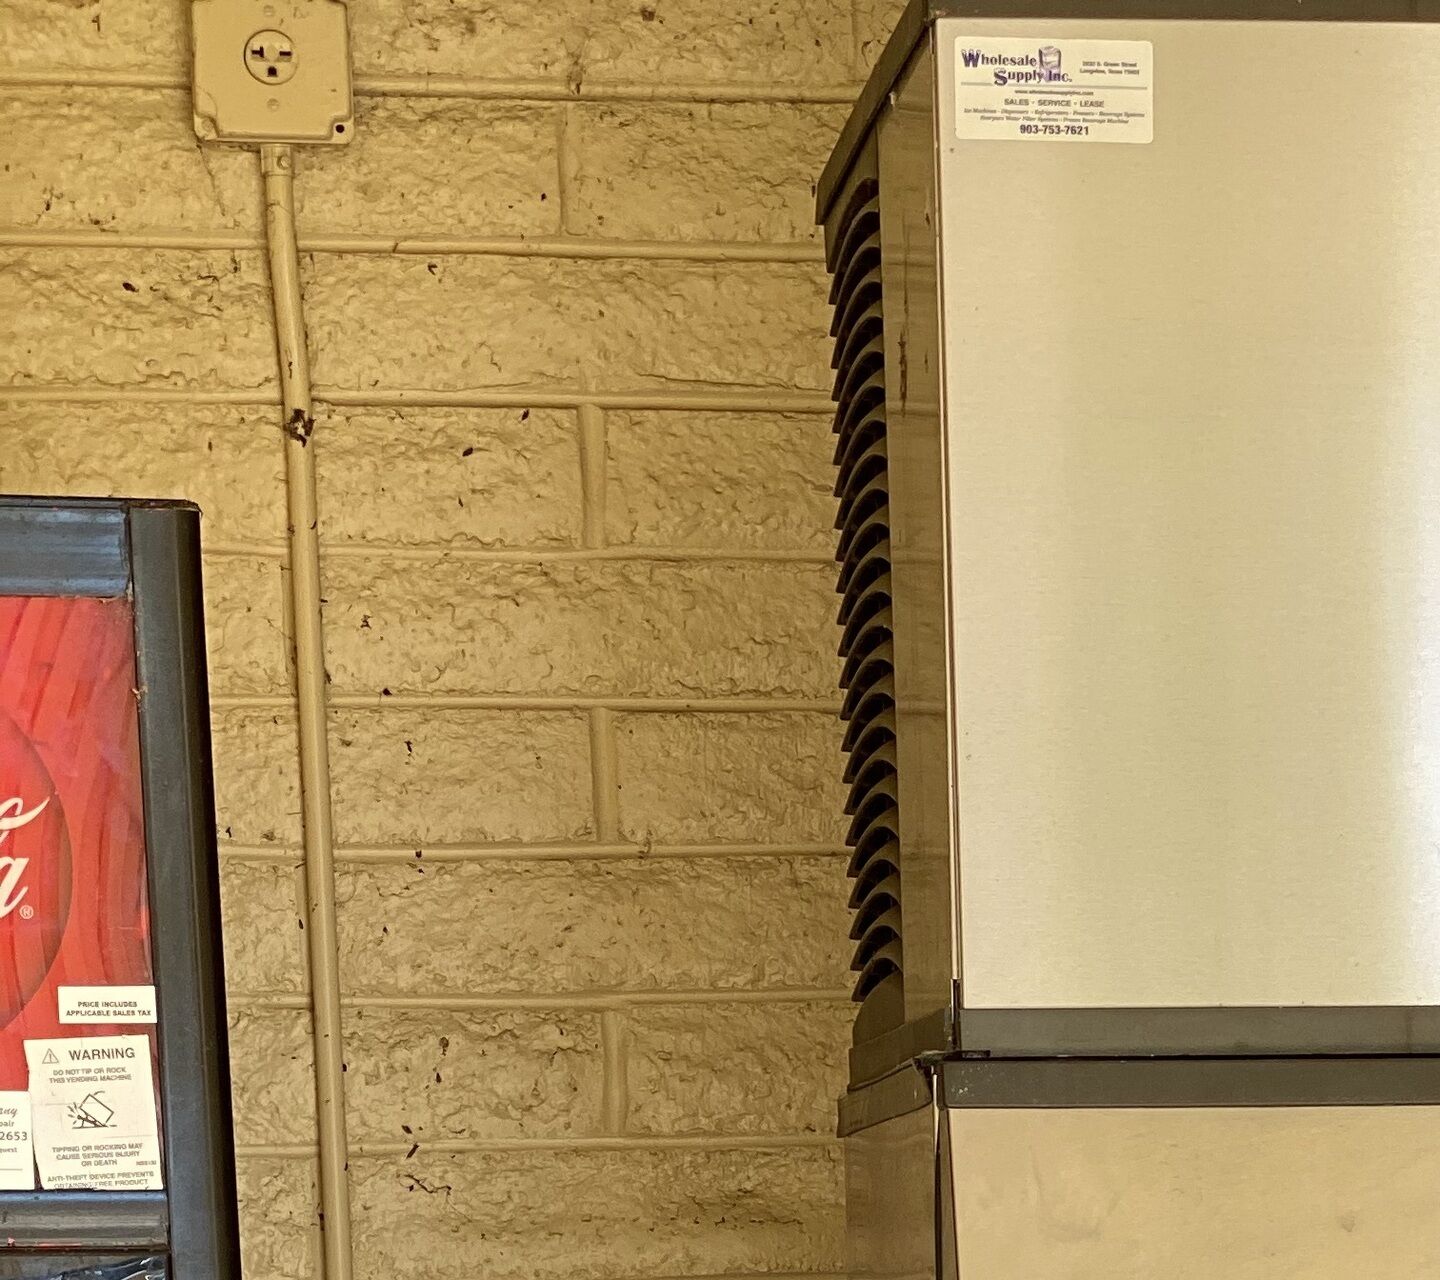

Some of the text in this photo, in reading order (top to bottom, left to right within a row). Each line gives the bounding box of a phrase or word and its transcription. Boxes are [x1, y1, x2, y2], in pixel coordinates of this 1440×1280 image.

[961, 49, 1036, 67] Wholesale
[994, 67, 1072, 86] Supply Inc.
[1004, 98, 1104, 108] SALES SERVICE LEASE
[1020, 124, 1089, 135] 903-753-7621
[68, 1047, 136, 1061] WARNING
[67, 1075, 98, 1083] VENDING
[99, 1073, 132, 1081] MACHINE
[94, 1143, 127, 1151] ROCKING
[56, 1153, 80, 1161] CAUSE
[89, 1172, 115, 1180] DEVICE
[117, 1171, 154, 1179] PREVENTS
